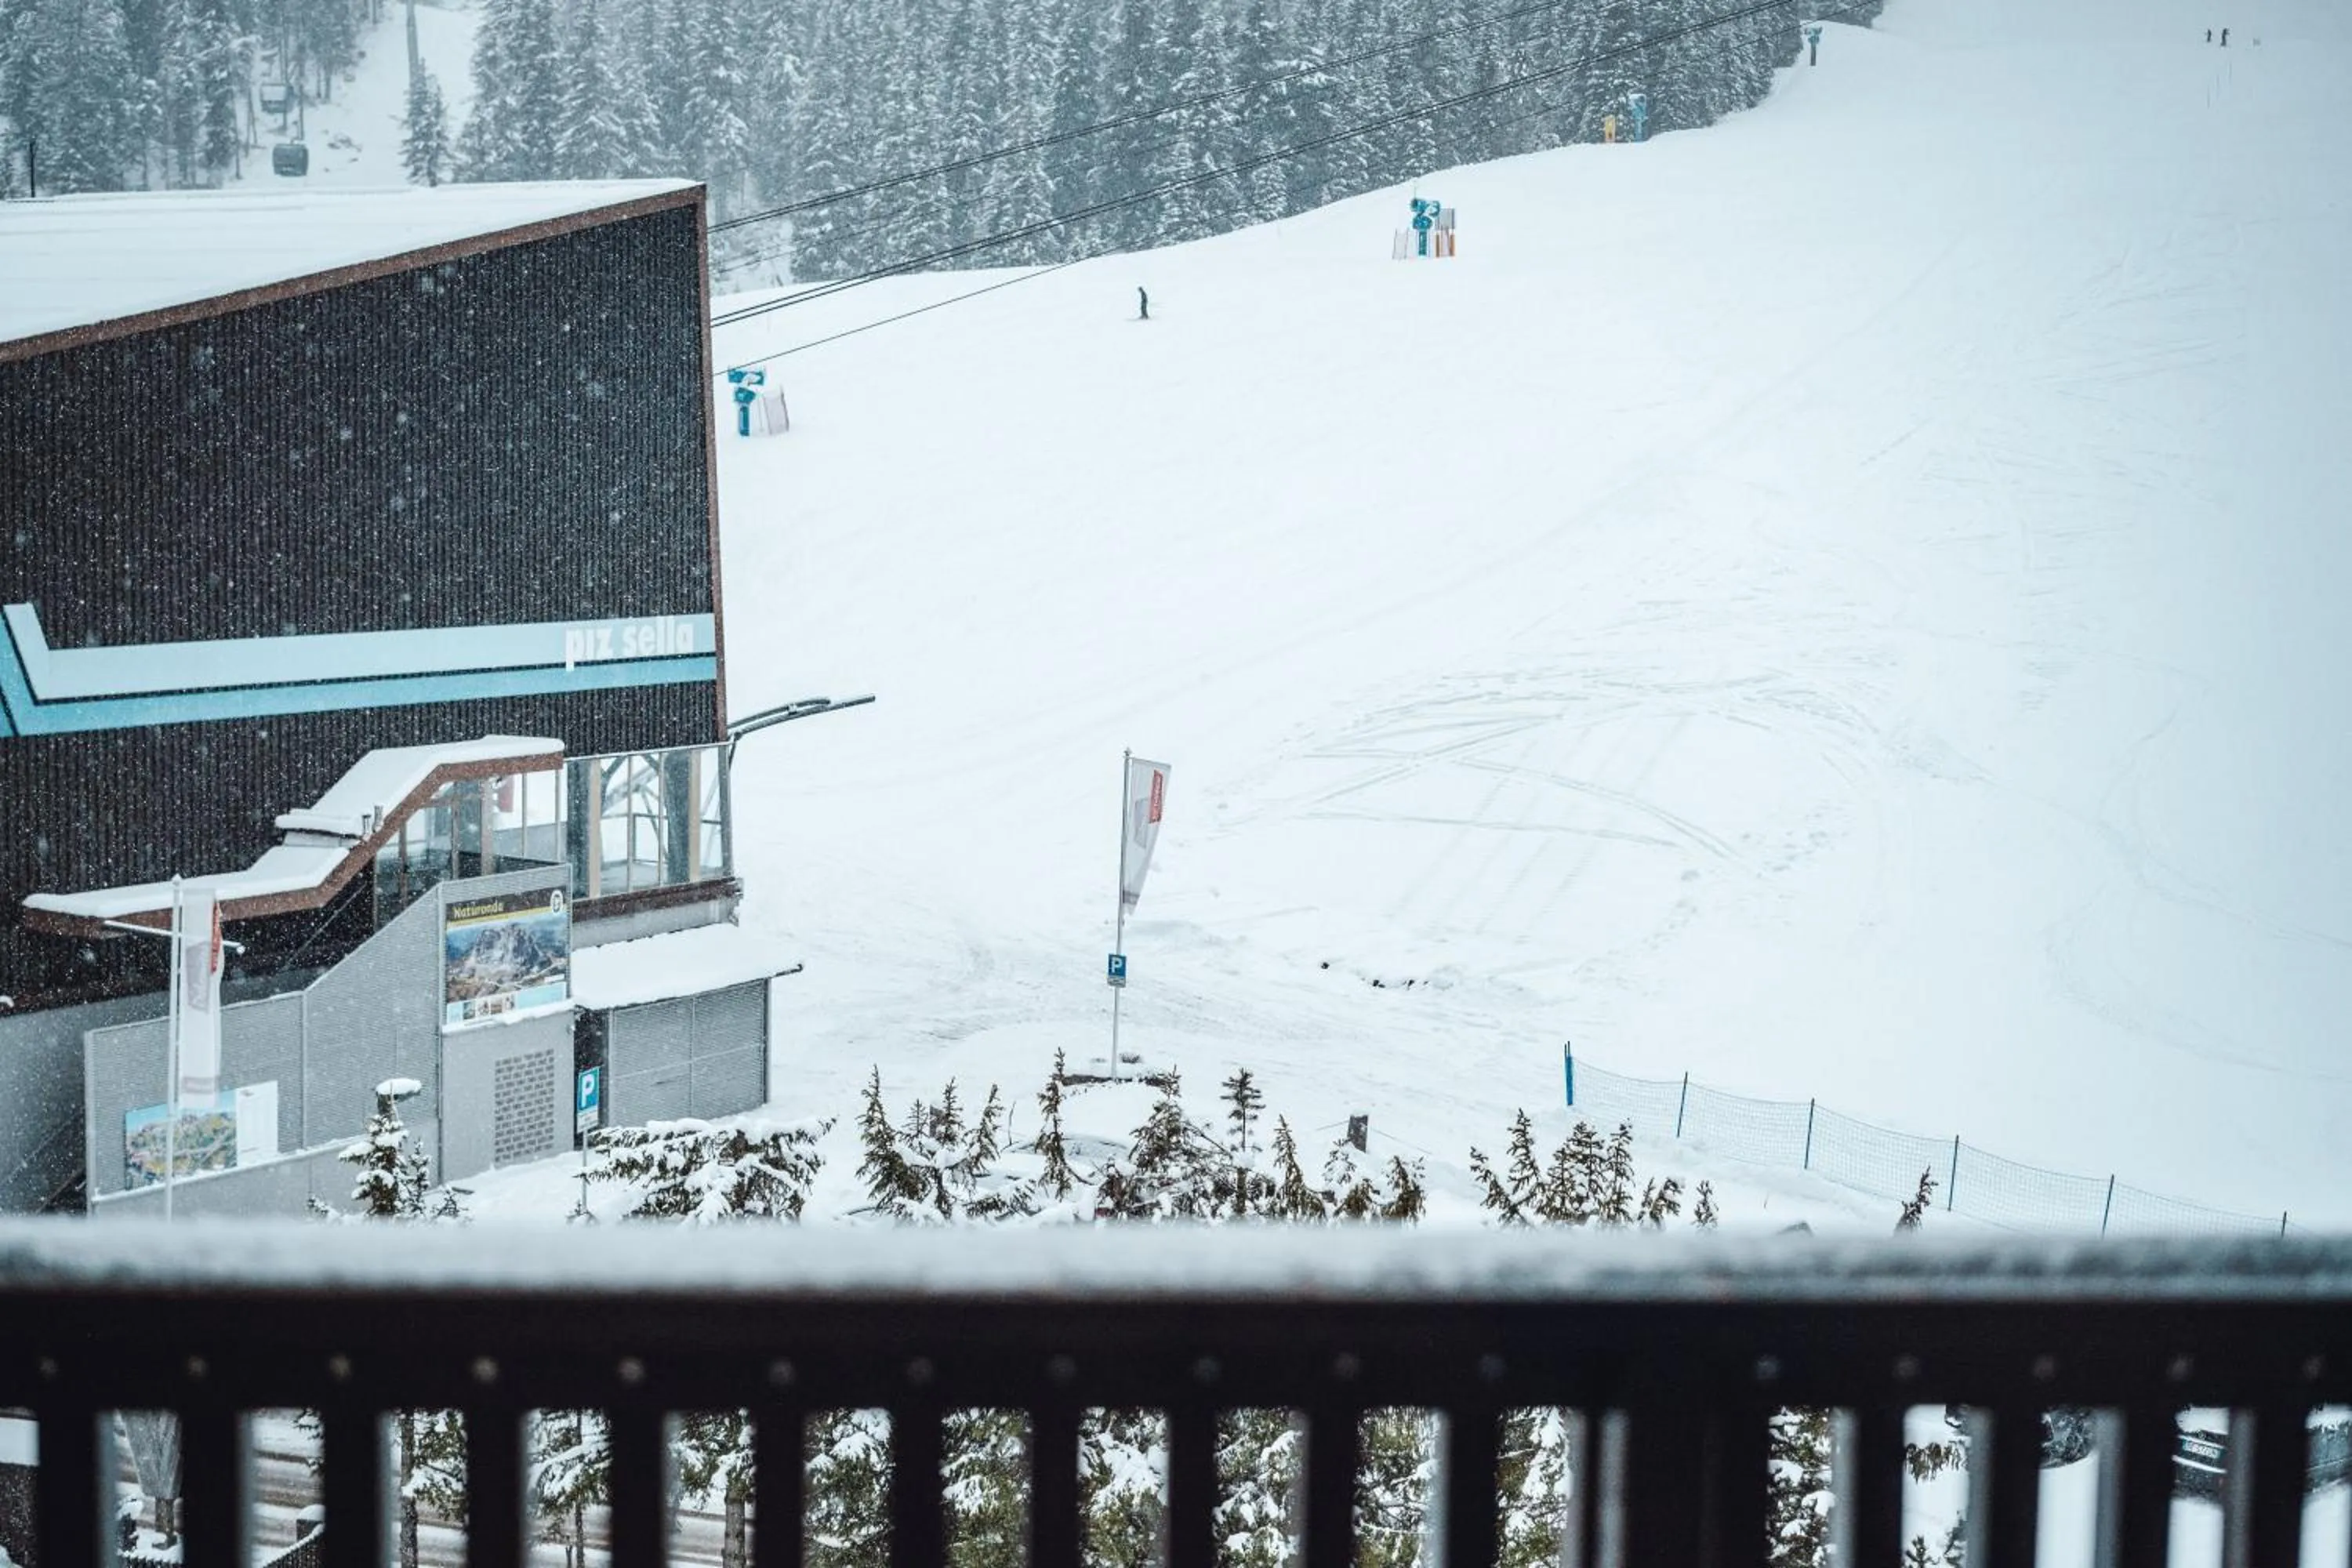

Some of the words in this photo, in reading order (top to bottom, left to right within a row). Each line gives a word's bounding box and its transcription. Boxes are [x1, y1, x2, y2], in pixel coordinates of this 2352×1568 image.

[622, 616, 694, 657] sella
[1111, 956, 1123, 973] P
[581, 1073, 595, 1108] P
